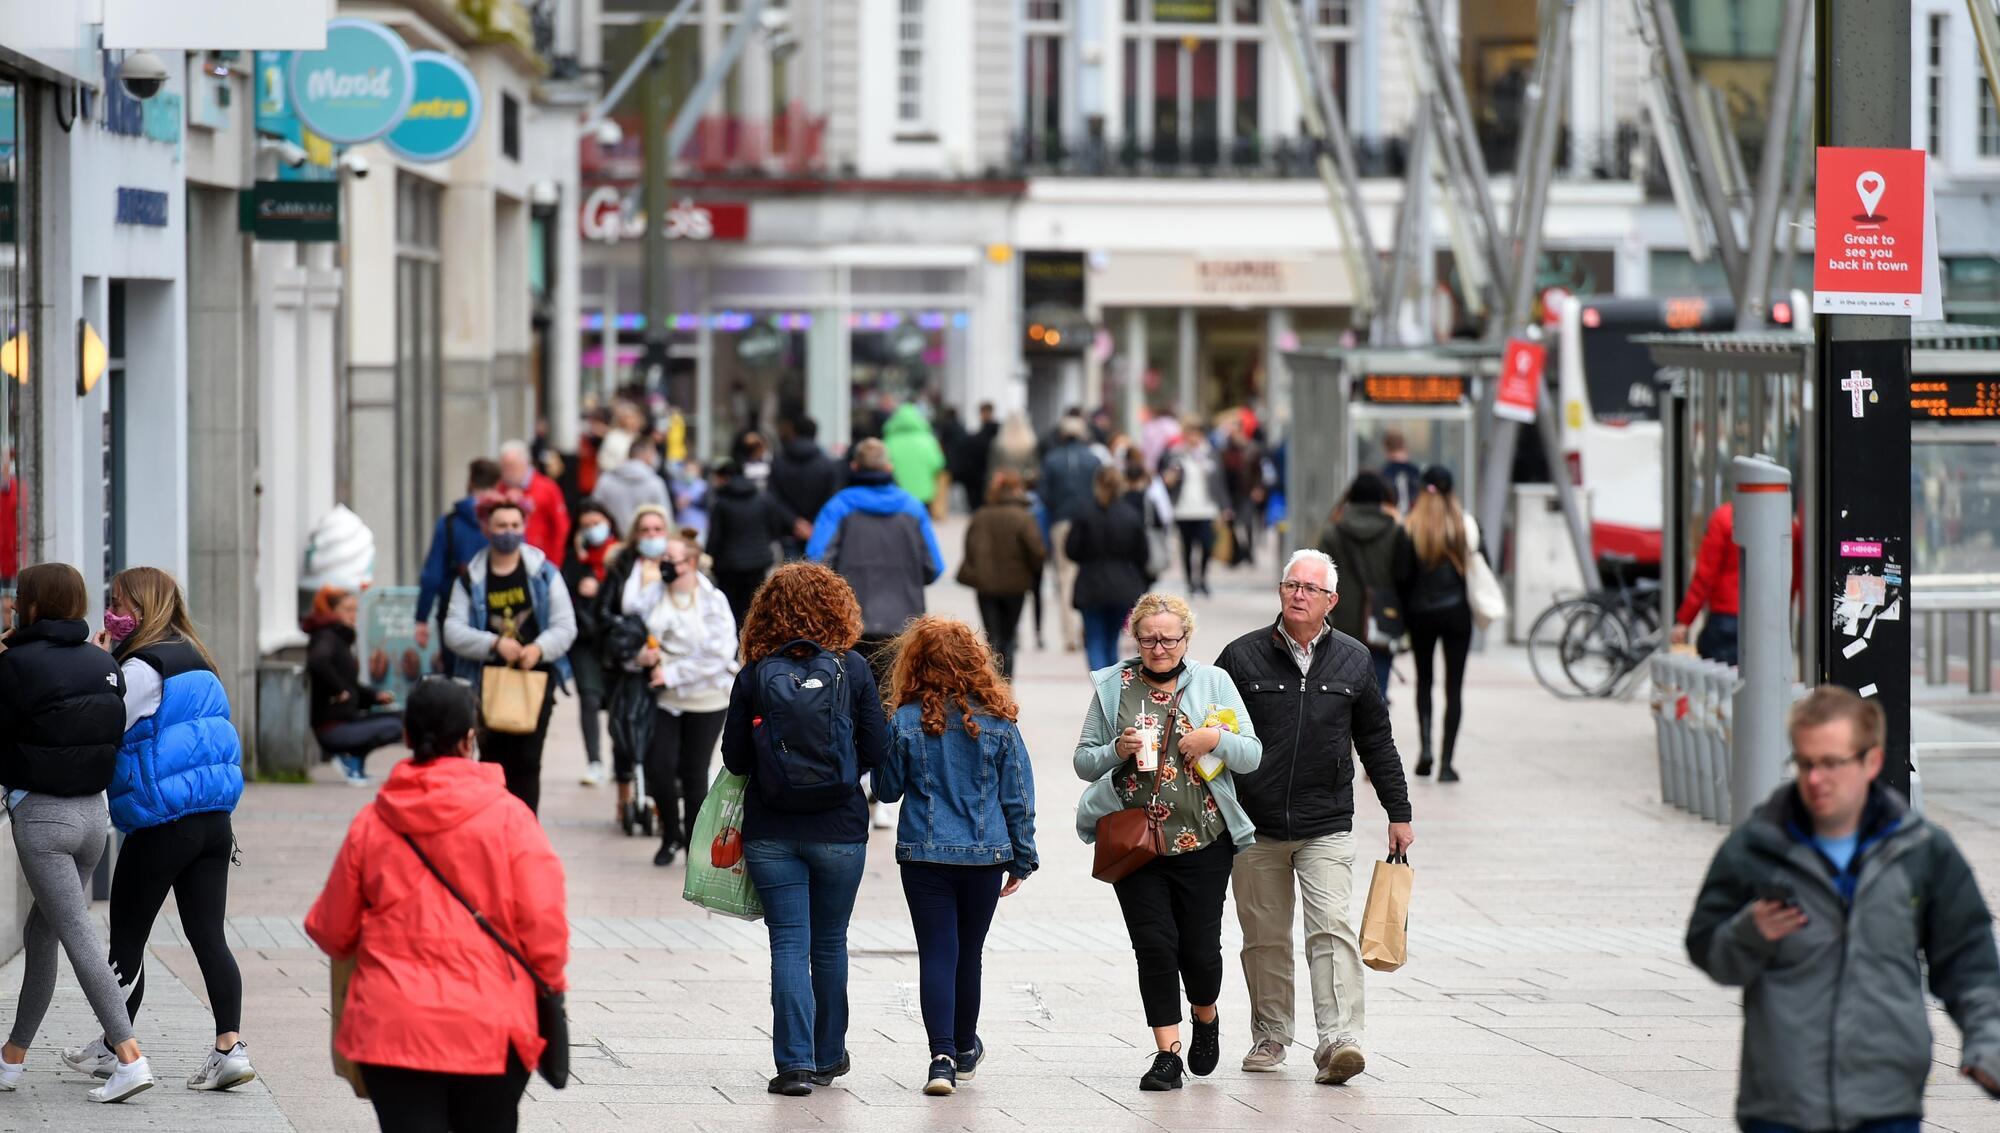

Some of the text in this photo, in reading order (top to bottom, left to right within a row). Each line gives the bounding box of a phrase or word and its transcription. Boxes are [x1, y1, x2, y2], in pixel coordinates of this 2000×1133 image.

[307, 66, 392, 102] Mood
[1843, 233, 1895, 245] Great to
[1845, 248, 1893, 259] see you
[1829, 259, 1909, 271] back in town
[1842, 380, 1871, 389] JESUS
